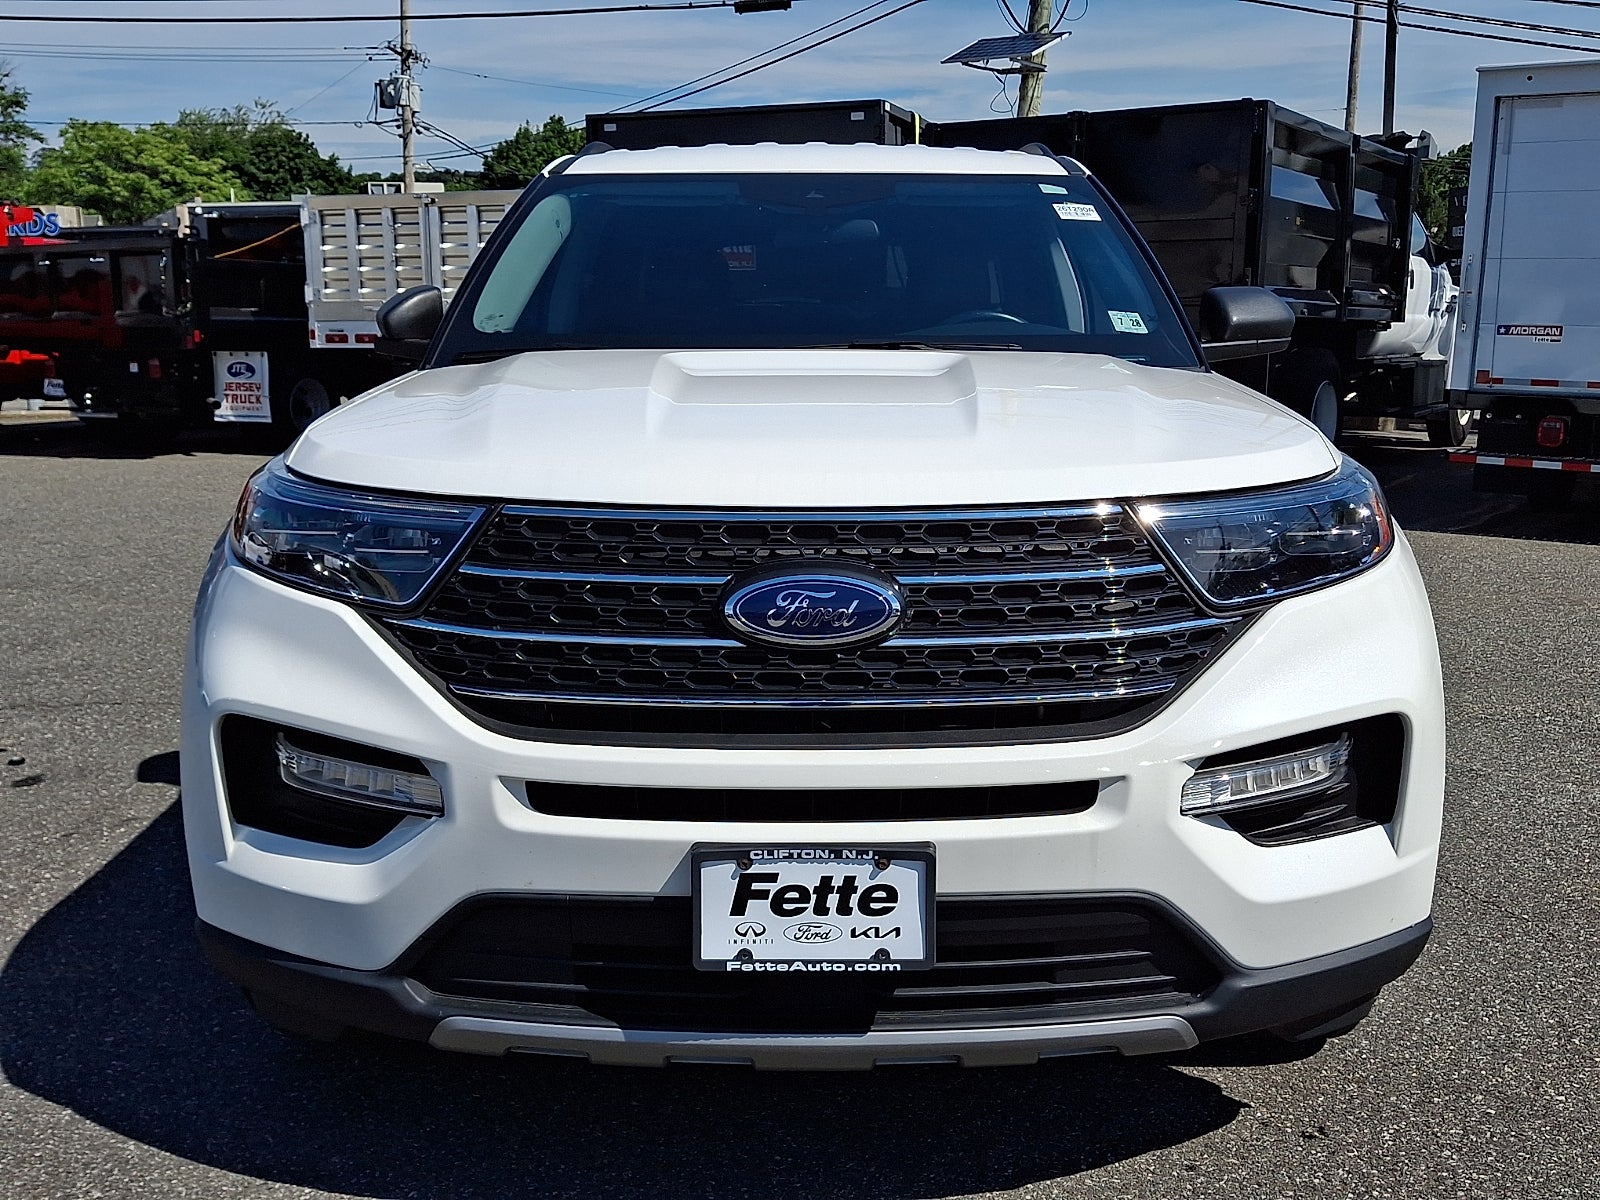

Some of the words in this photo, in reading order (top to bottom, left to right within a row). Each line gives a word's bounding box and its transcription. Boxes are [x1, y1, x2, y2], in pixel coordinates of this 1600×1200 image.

[1117, 317, 1123, 326] 7
[1129, 318, 1142, 327] 28
[1508, 326, 1561, 336] MORGAN
[231, 364, 247, 373] JTE
[224, 382, 262, 392] JERSEY
[224, 394, 262, 404] TRUCK
[767, 589, 859, 627] Ford
[749, 849, 834, 861] CLIFTON,
[842, 850, 879, 860] N.J.
[729, 872, 899, 918] Fette
[793, 923, 832, 942] Ford
[726, 960, 901, 972] FetteAuto.com
